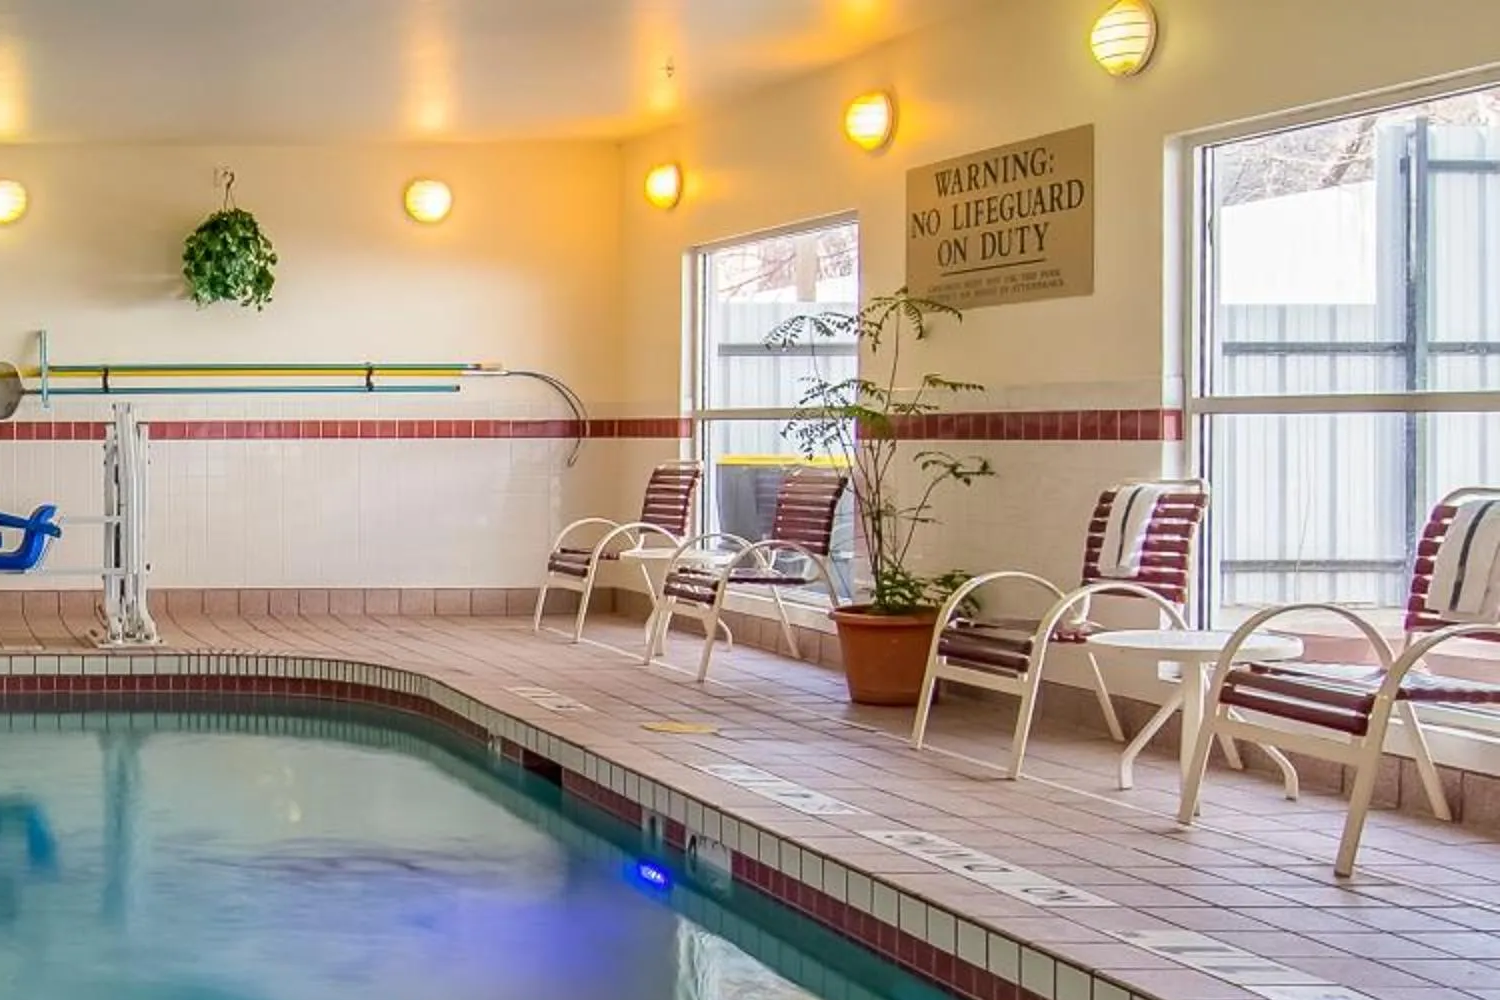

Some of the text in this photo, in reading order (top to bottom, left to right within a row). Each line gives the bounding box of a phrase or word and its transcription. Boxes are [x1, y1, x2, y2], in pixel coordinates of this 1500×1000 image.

[934, 147, 1055, 198] WARNING:
[911, 179, 1085, 239] NO LIFEGUARD
[937, 221, 1050, 267] ON DUTY
